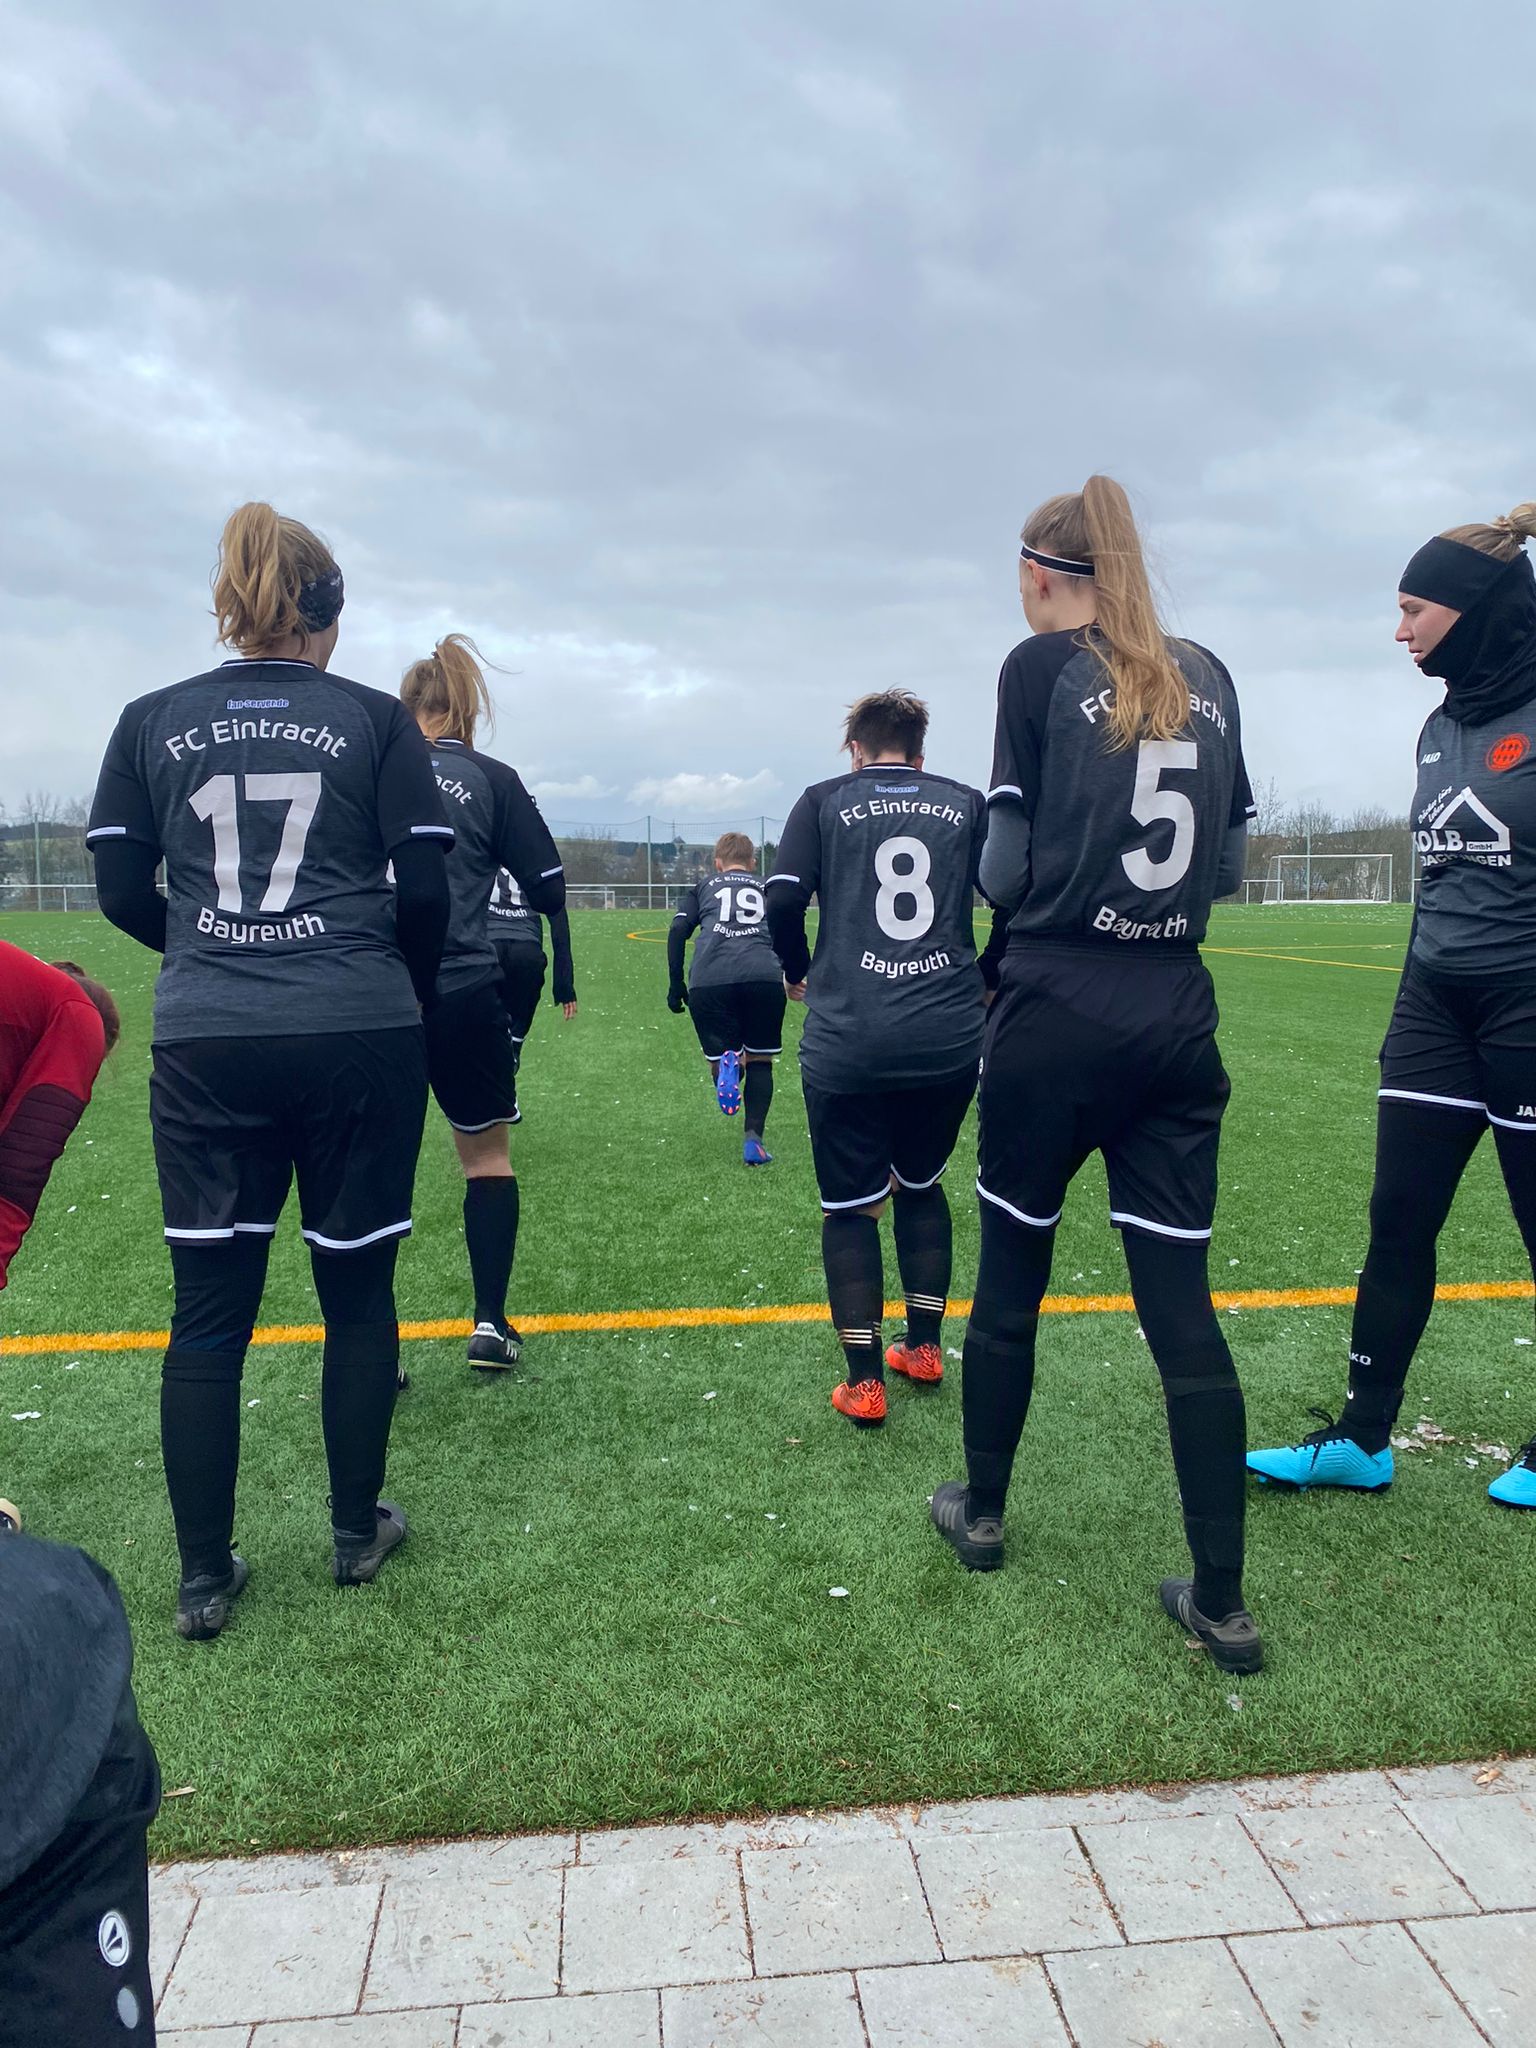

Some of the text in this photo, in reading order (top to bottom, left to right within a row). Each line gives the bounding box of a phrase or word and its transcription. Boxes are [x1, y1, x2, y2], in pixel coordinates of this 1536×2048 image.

[1079, 688, 1113, 724] FC
[165, 718, 349, 761] FC Eintracht
[839, 799, 965, 827] FC Eintracht
[1121, 739, 1198, 892] 5
[188, 772, 322, 914] 17
[724, 876, 765, 891] Eintrach
[874, 836, 935, 941] 8
[714, 887, 765, 924] 19
[197, 907, 326, 945] Bayreuth
[713, 923, 760, 938] Bayreuth
[860, 950, 951, 979] Bayreuth
[1516, 1105, 1536, 1117] JA
[1350, 1352, 1371, 1365] KO
